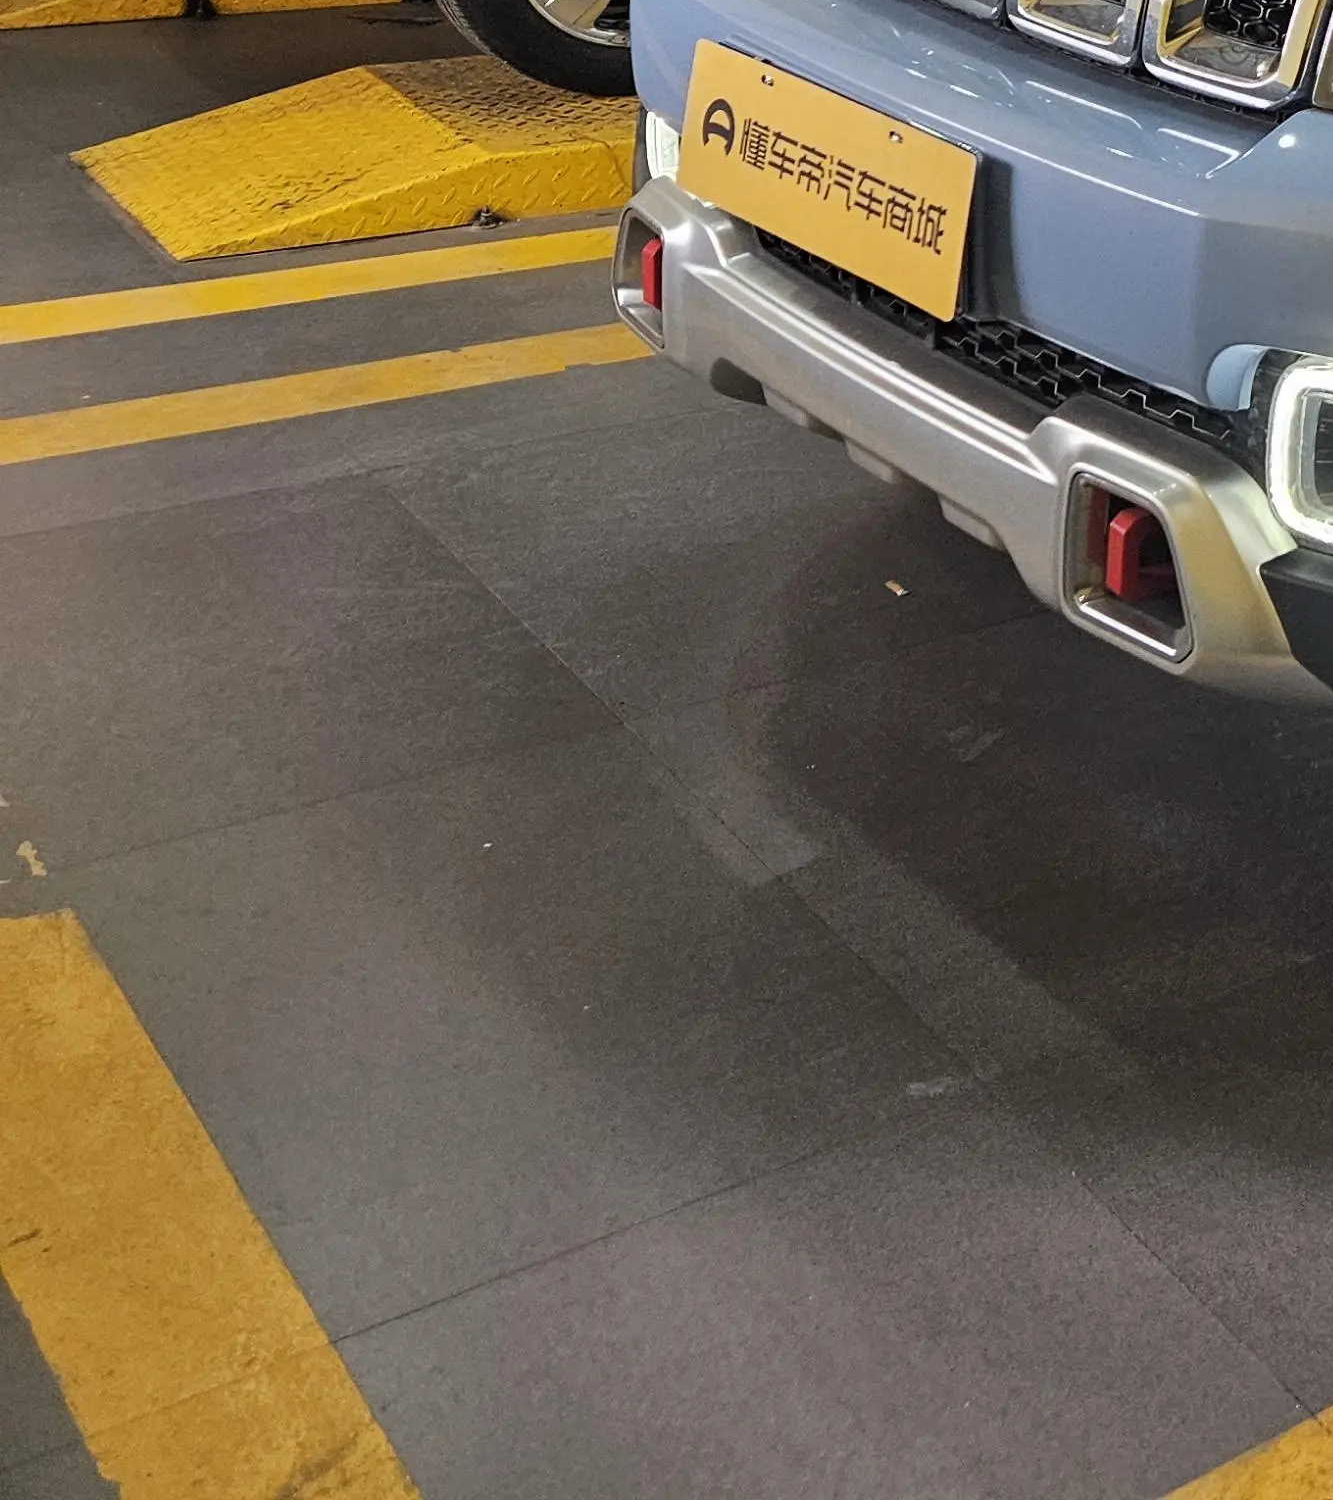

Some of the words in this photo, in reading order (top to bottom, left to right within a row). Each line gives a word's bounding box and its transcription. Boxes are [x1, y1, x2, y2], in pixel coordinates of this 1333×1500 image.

[738, 117, 949, 256] 懂车帝汽车商城
